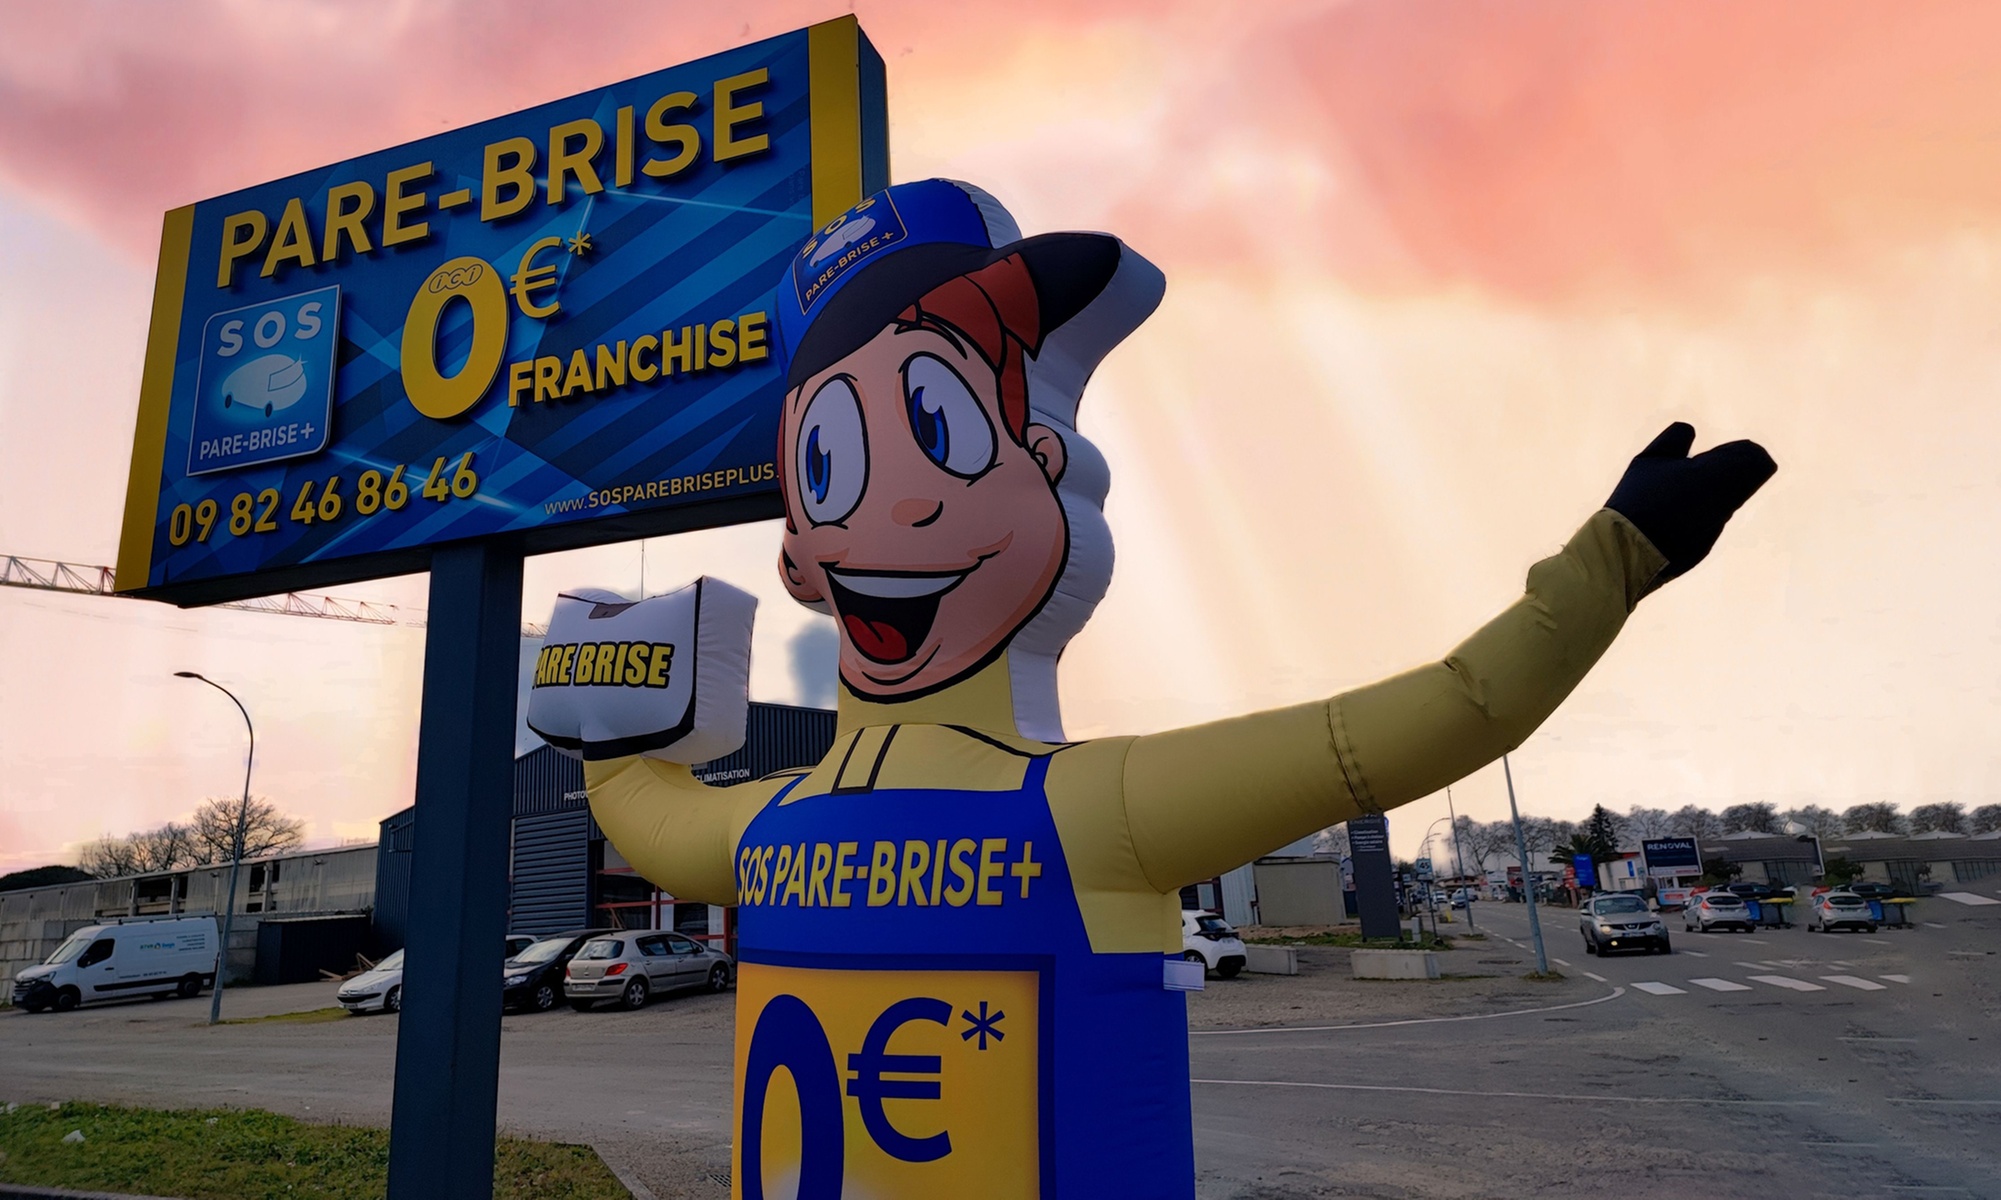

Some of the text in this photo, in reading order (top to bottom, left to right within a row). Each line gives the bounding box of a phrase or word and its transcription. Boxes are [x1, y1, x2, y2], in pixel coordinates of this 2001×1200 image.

[217, 67, 770, 288] PARE-BRISE
[801, 197, 877, 260] SOS
[216, 301, 323, 358] SOS
[507, 311, 769, 408] FRANCHISE
[168, 451, 478, 546] 09 82 46 86 46
[574, 642, 674, 688] BRISE
[738, 845, 775, 906] SOS
